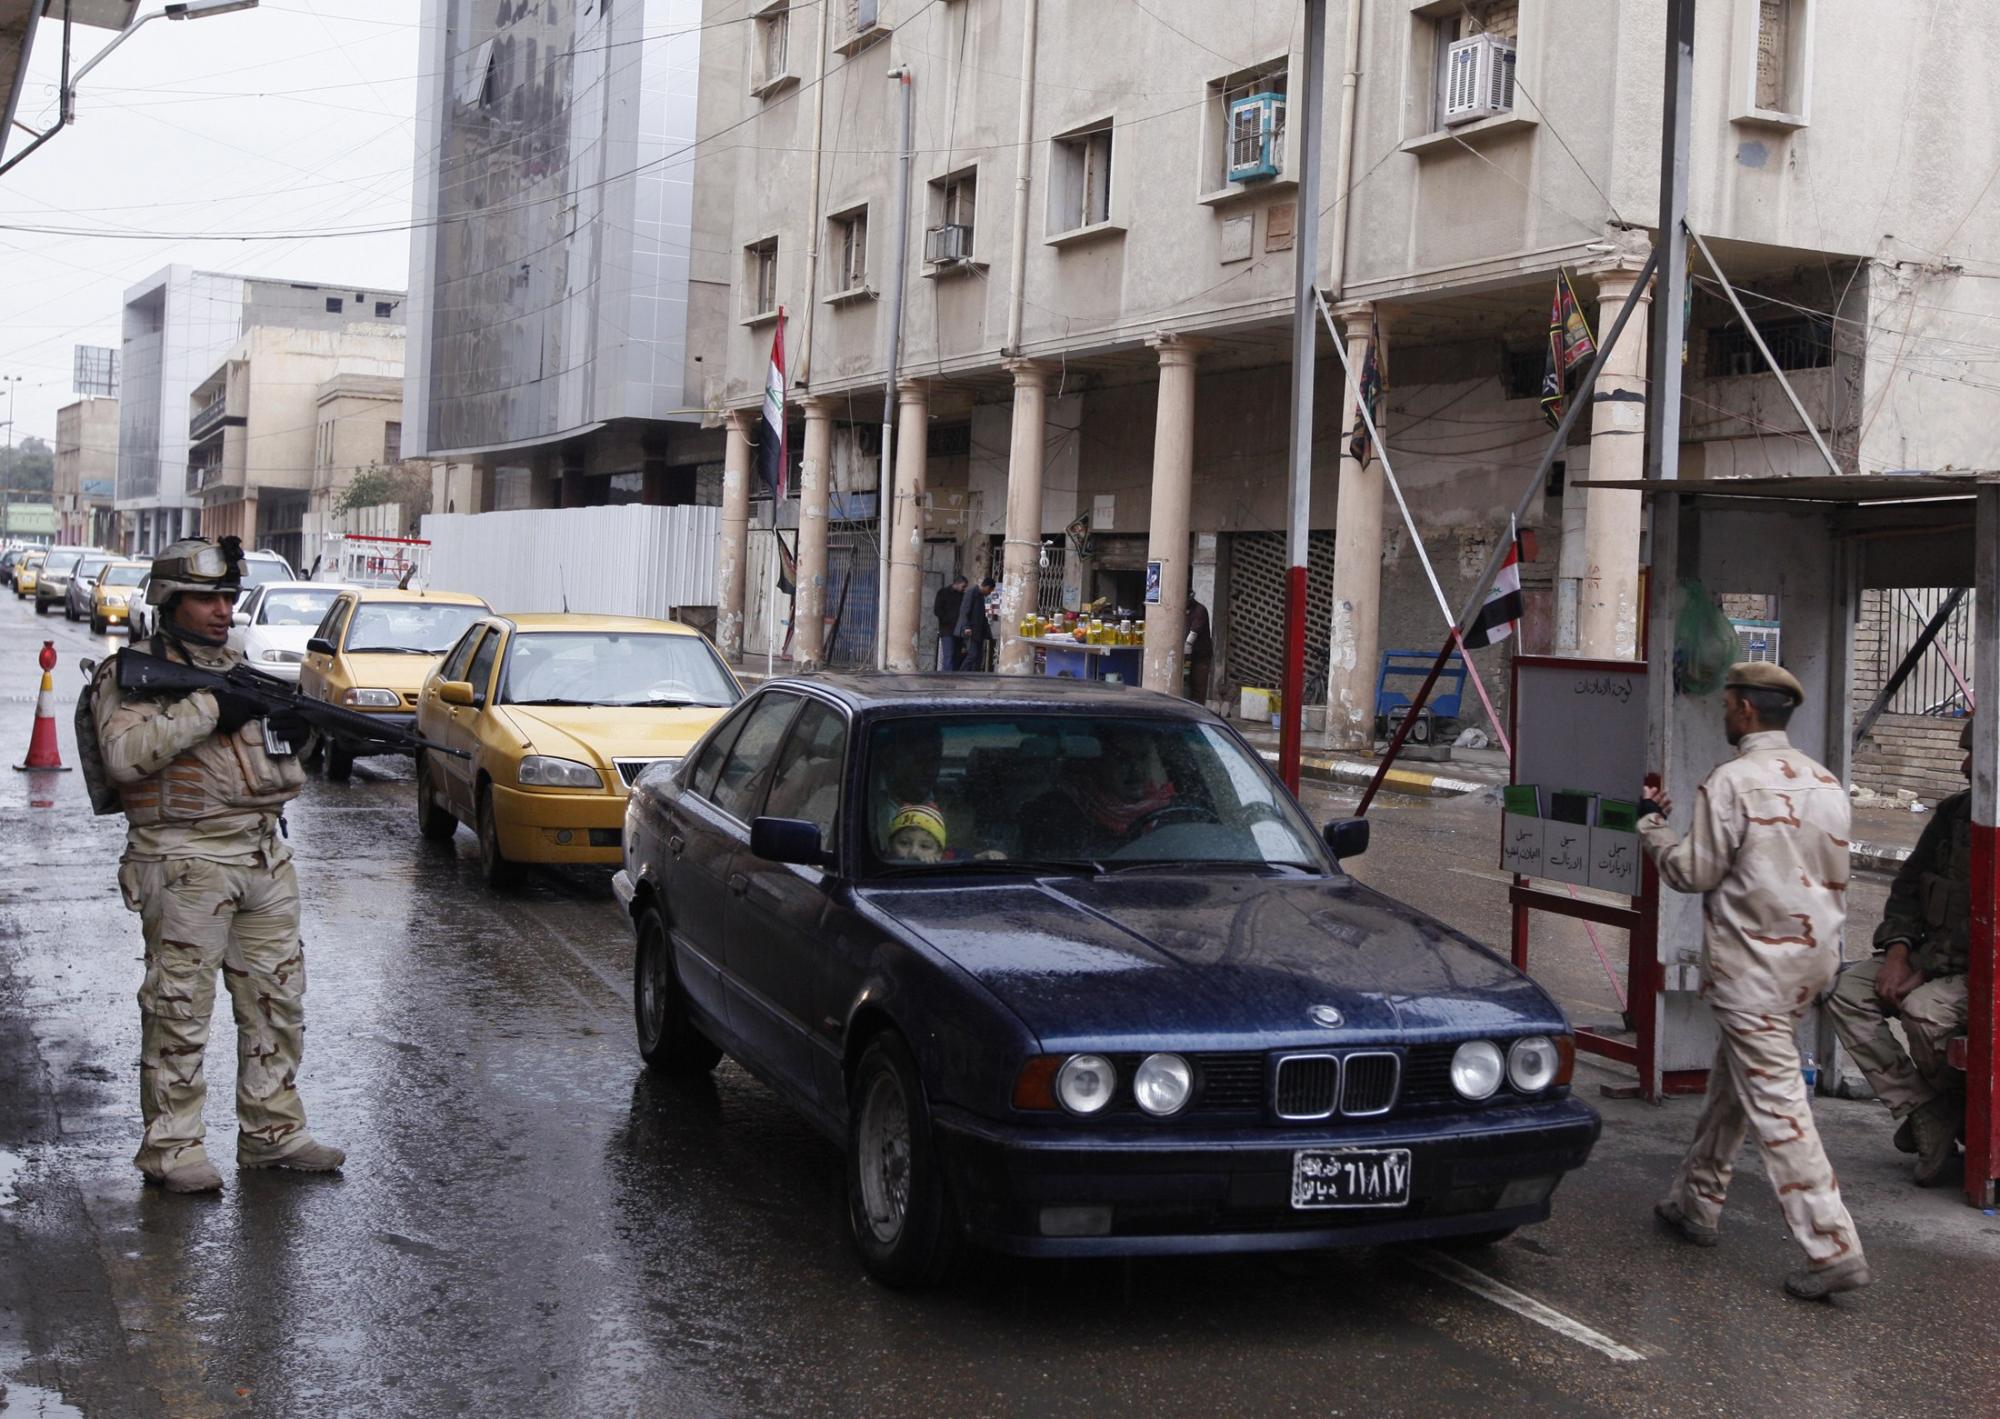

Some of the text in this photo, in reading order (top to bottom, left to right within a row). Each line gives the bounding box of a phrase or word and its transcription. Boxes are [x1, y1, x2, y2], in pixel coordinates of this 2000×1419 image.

[1611, 677, 1632, 704] لوحة
[1608, 842, 1627, 858] سجل
[1344, 1161, 1406, 1196] ٦١٨١٧
